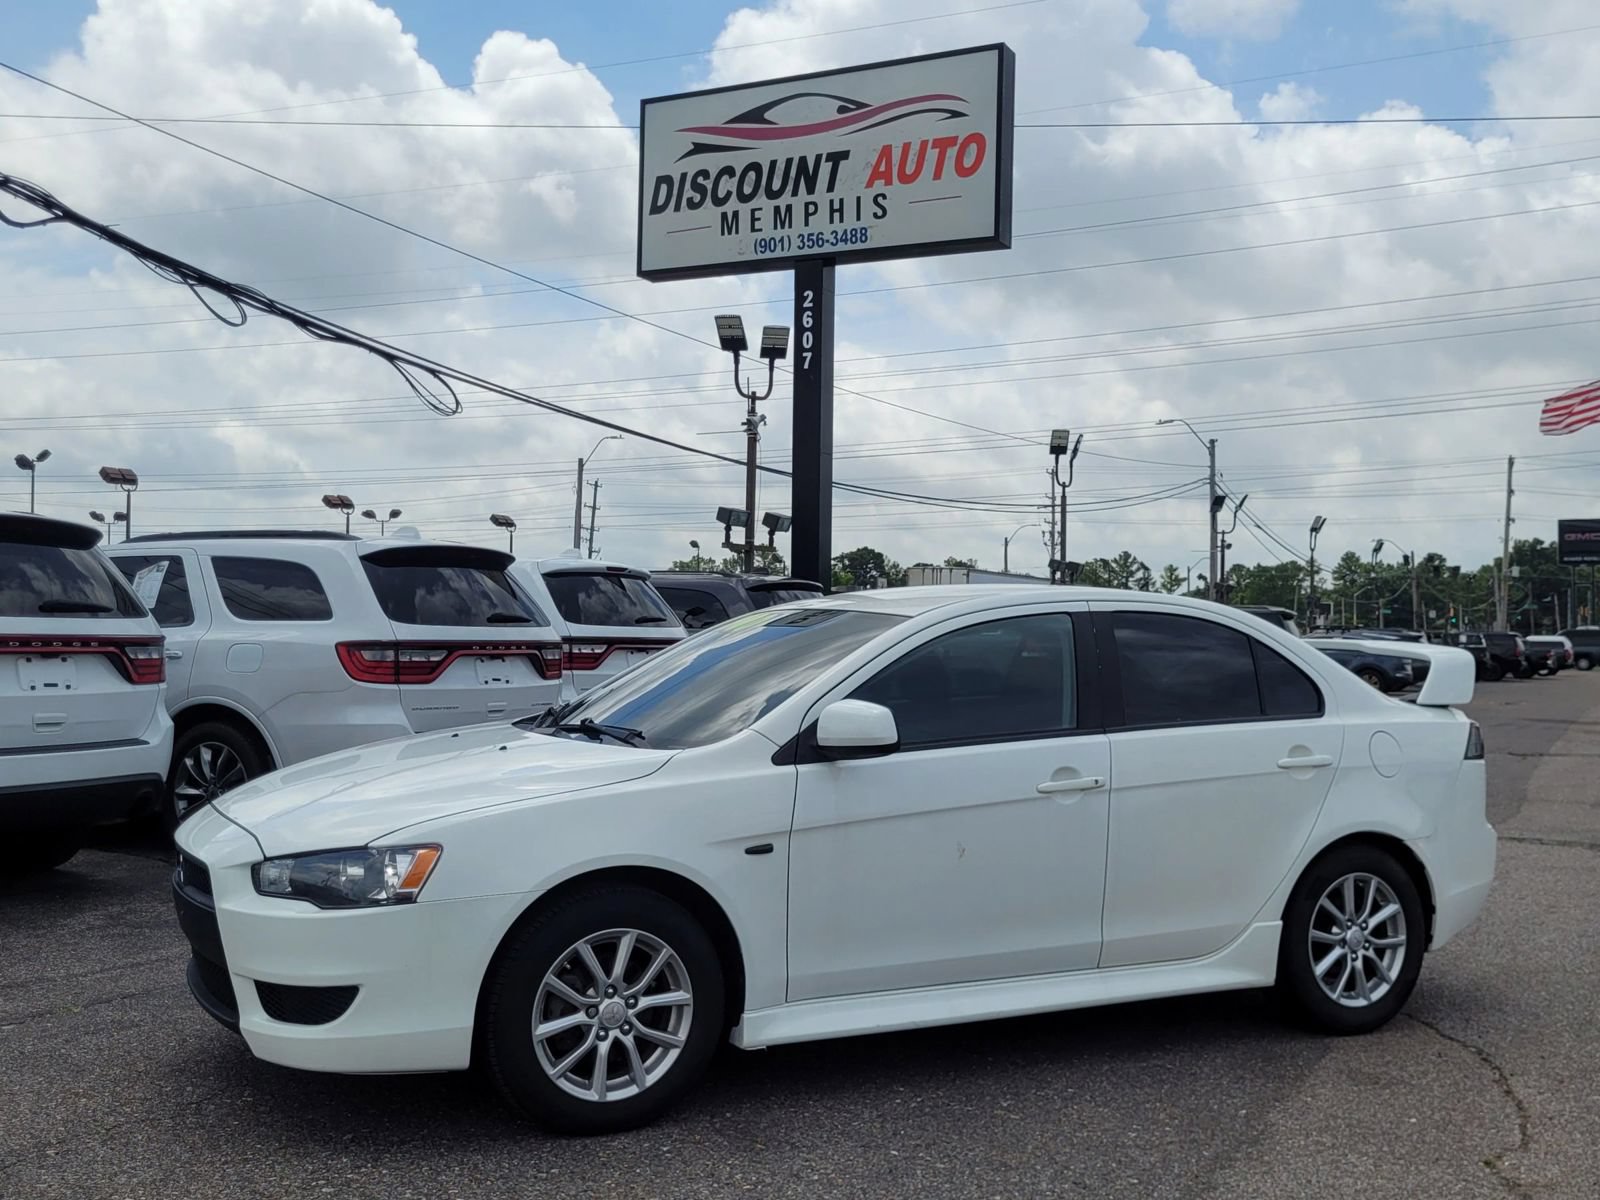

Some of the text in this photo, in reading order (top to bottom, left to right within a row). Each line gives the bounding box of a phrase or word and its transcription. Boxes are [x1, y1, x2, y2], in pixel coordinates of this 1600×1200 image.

[649, 132, 987, 216] DISCOUNT AUTO
[720, 193, 888, 236] MEMPHIS
[753, 227, 868, 256] (901) 356-3488
[802, 290, 814, 370] 2607
